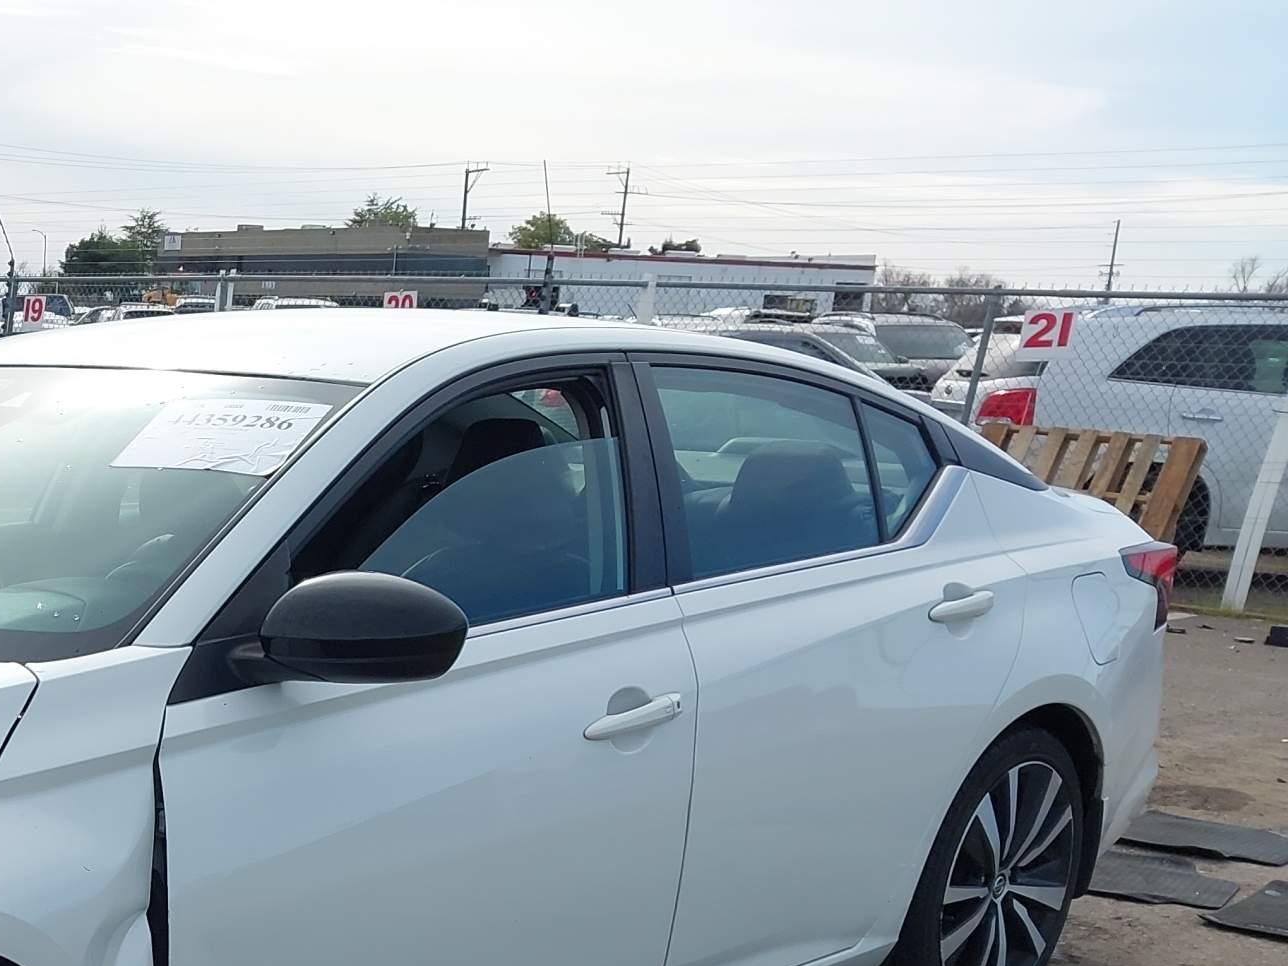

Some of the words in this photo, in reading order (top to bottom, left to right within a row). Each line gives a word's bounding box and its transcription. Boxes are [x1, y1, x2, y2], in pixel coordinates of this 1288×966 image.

[24, 298, 43, 322] 19
[1023, 312, 1074, 348] 21
[168, 413, 294, 431] 44359286
